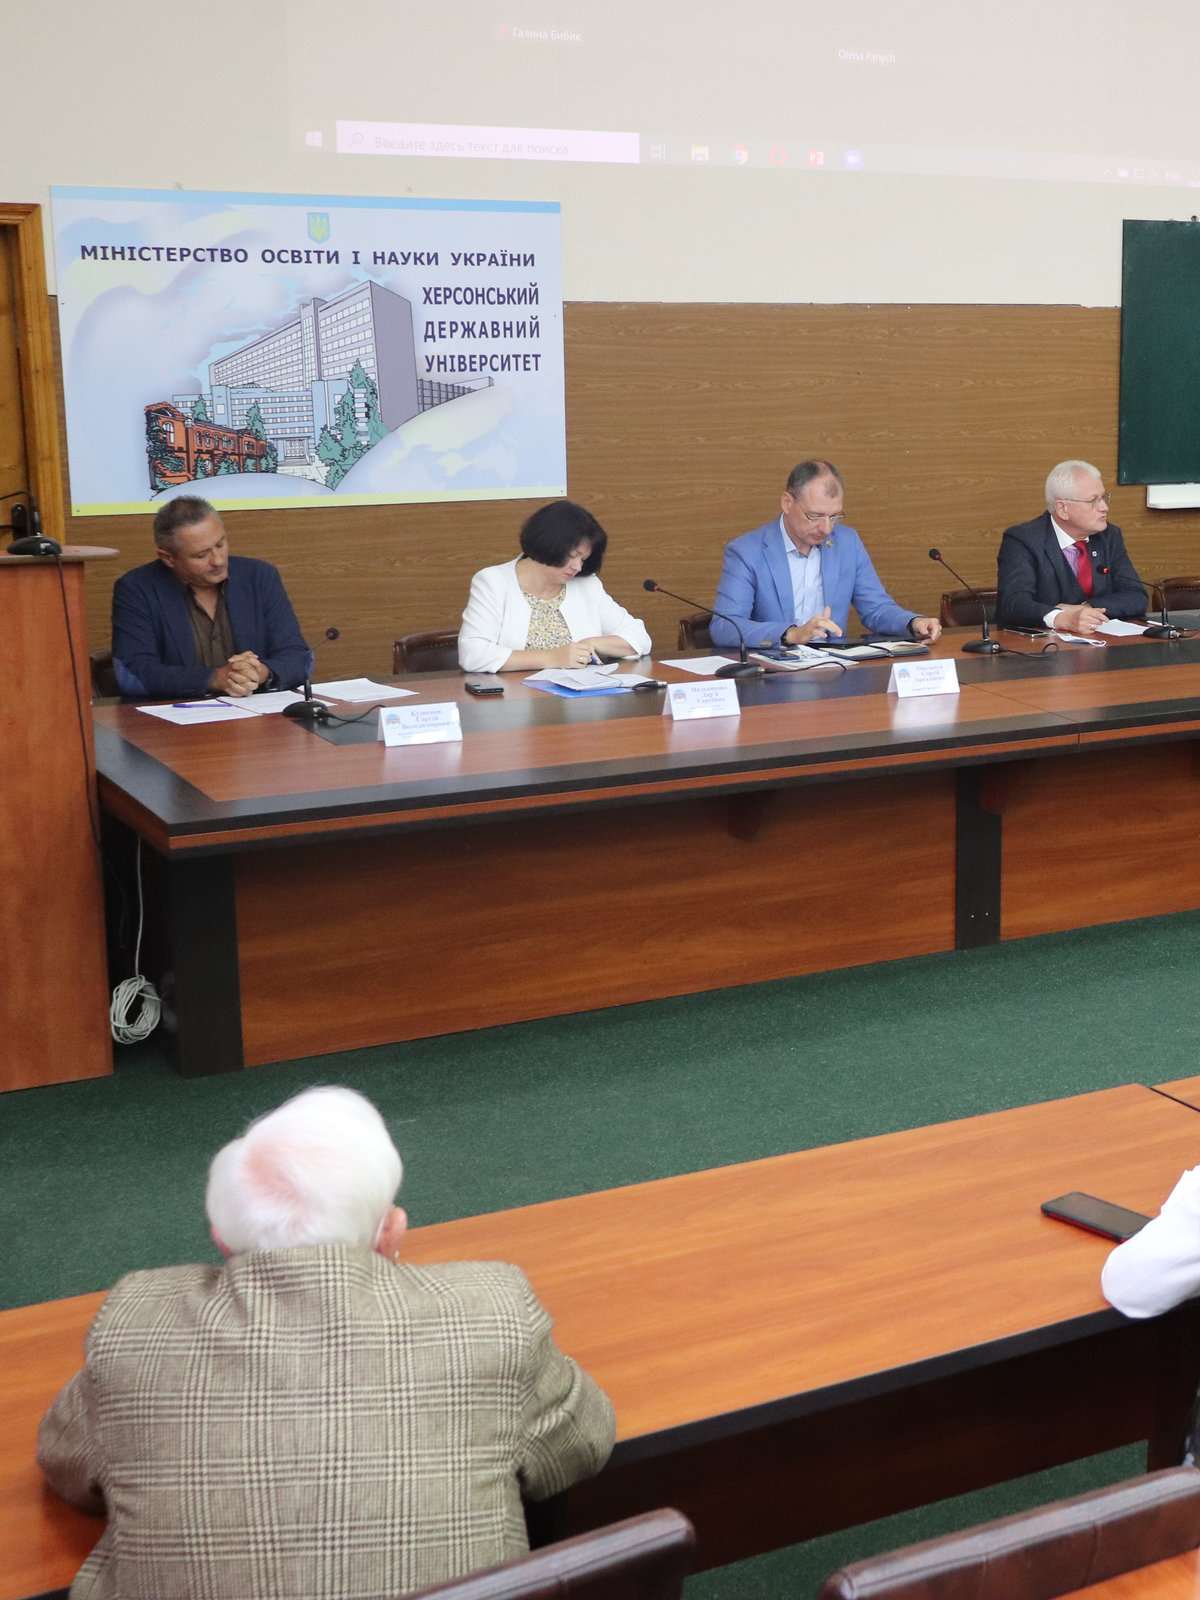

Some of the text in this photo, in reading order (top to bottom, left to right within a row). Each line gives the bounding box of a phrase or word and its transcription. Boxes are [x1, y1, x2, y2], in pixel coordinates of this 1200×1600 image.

[512, 26, 548, 40] Галина
[375, 136, 569, 156] Введите здесь текст для поиска
[80, 245, 535, 267] МІНІСТЕРСТВО ОСВІТИ І НАУКИ УКРАЇНИ
[422, 281, 539, 306] ХЕРСОНСЬКИЙ
[423, 315, 540, 343] ДЕРЖАВНИЙ
[424, 353, 541, 373] УНІВЕРСИТЕТ
